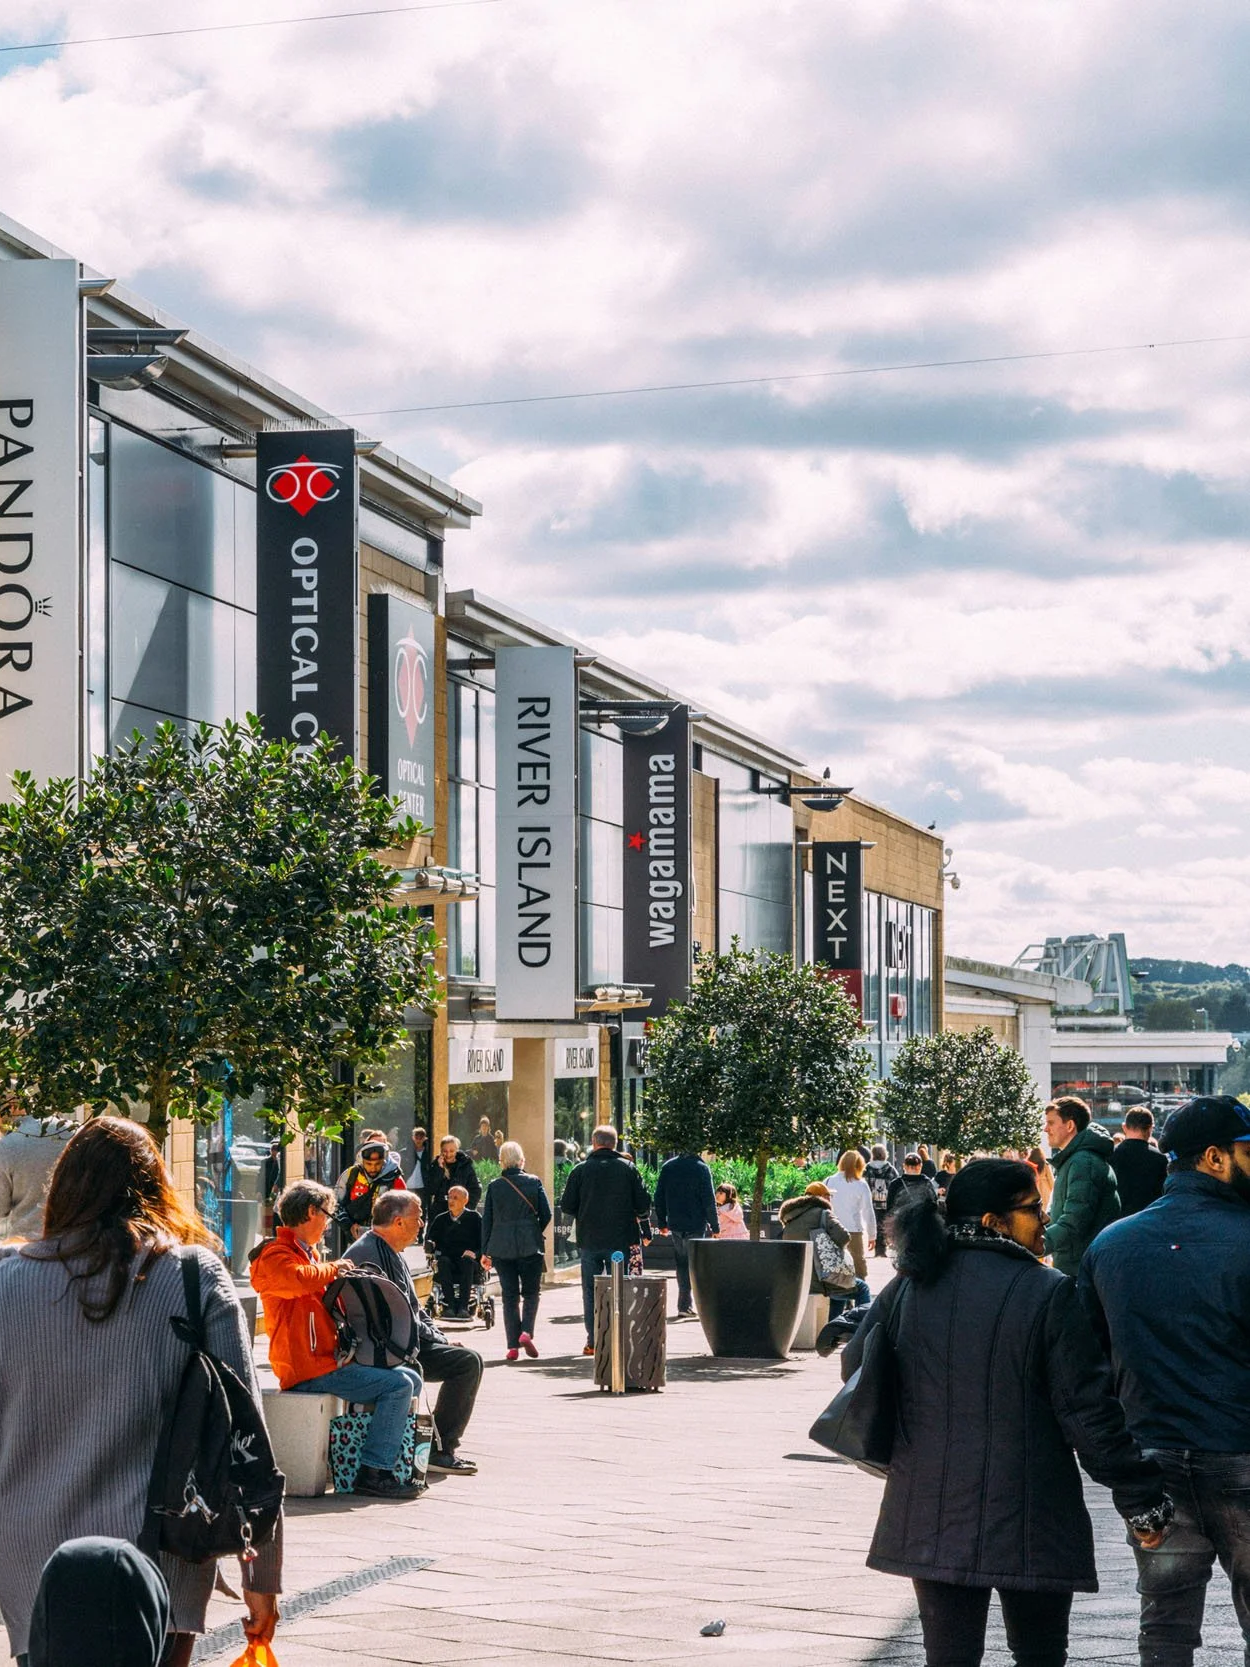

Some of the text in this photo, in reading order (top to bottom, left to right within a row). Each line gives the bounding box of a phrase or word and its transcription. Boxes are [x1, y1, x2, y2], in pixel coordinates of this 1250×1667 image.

[291, 536, 319, 702] OPTICAL
[397, 758, 426, 786] OPTICAL
[517, 696, 551, 969] RIVER ISLAND
[648, 753, 683, 949] wagamama
[826, 852, 848, 959] NEXT
[467, 1048, 504, 1073] RIVER ISLAND
[566, 1047, 595, 1069] RIVER ISLAND
